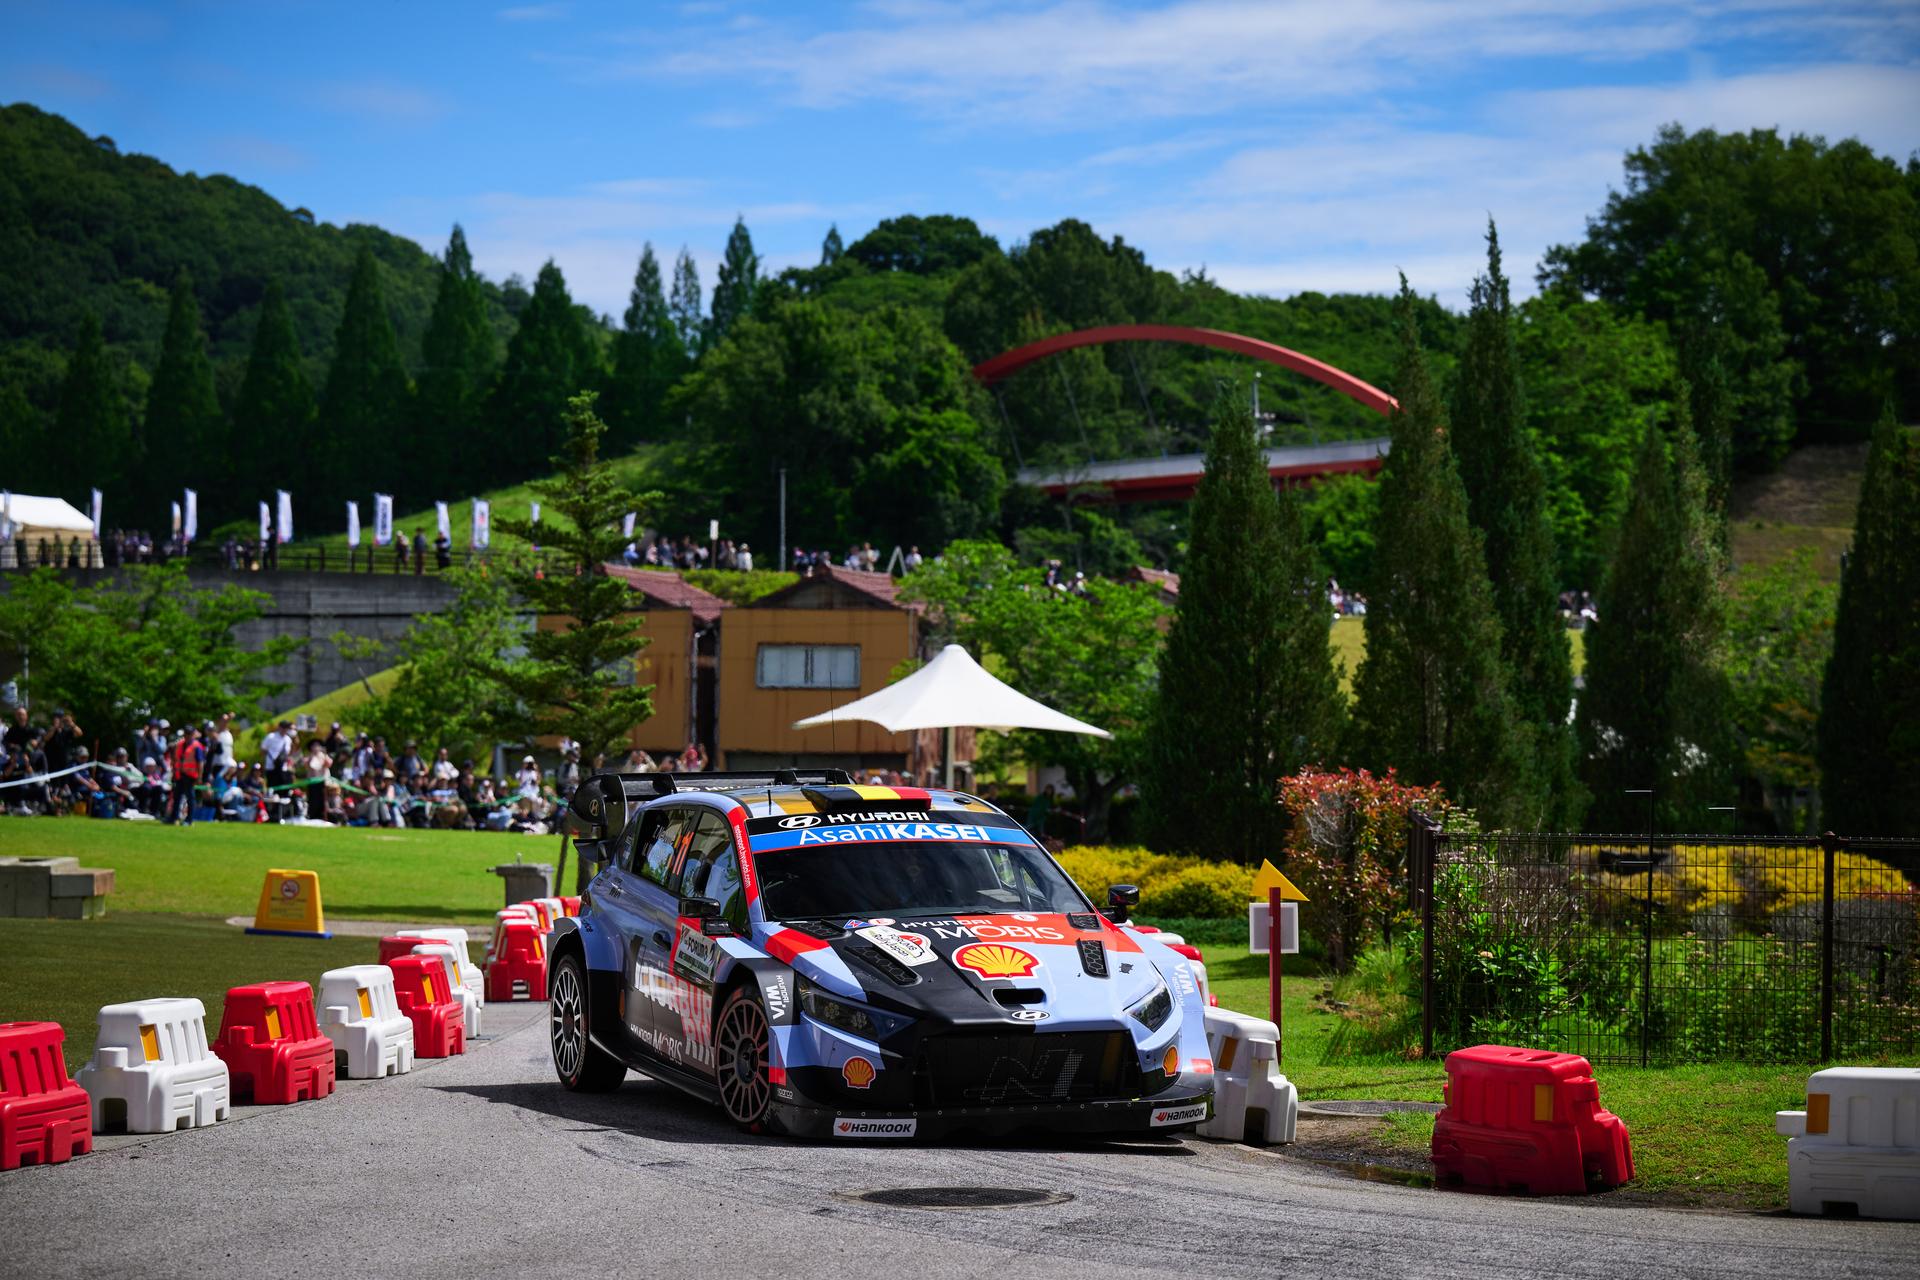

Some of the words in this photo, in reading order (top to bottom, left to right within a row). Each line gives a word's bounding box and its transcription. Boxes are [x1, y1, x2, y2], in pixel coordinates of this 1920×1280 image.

[827, 811, 931, 824] HYUNDAI
[799, 823, 992, 846] AsahiKASEI
[901, 919, 992, 929] HYUNDAI
[931, 925, 1065, 940] MOBIS
[775, 974, 790, 1003] HYUNDAI
[653, 1029, 682, 1065] MOBIS
